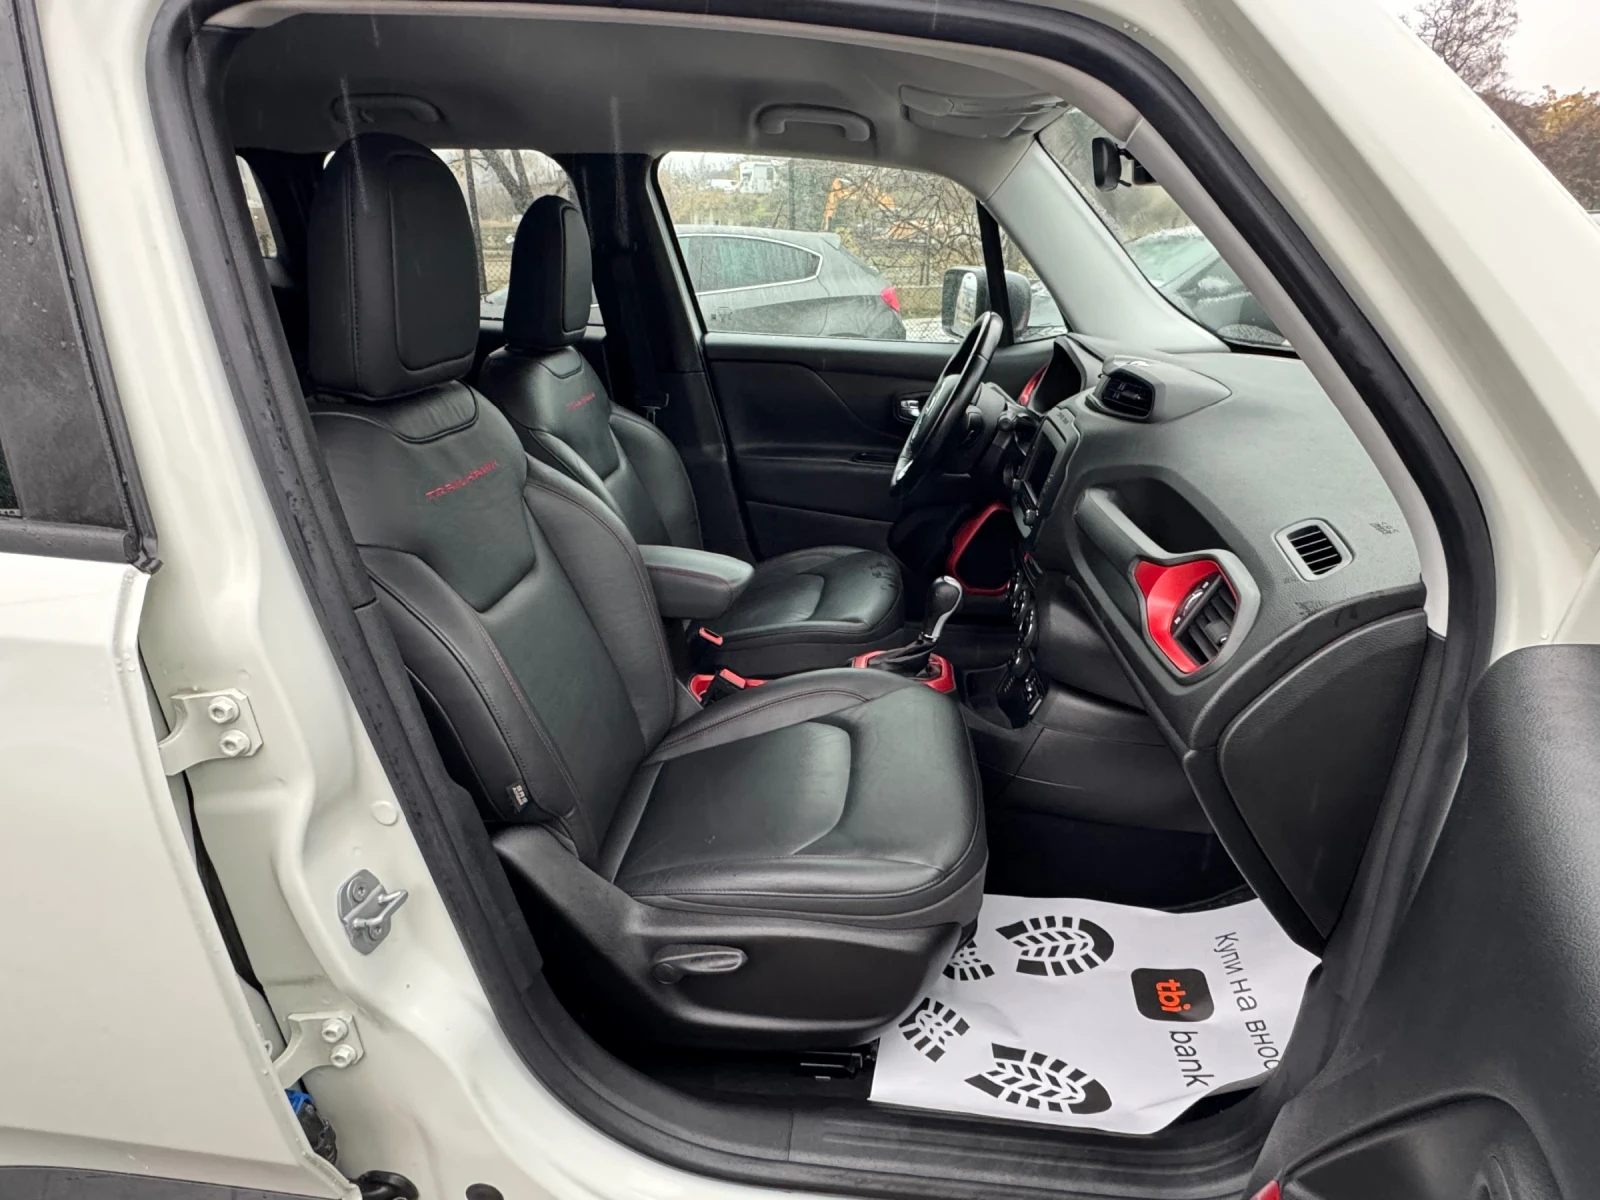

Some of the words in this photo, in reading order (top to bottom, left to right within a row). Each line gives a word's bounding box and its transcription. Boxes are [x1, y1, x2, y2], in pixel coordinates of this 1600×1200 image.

[1155, 978, 1191, 1012] tbi
[1214, 932, 1244, 975] Купи
[1230, 978, 1257, 1011] на
[1169, 1030, 1214, 1087] bank
